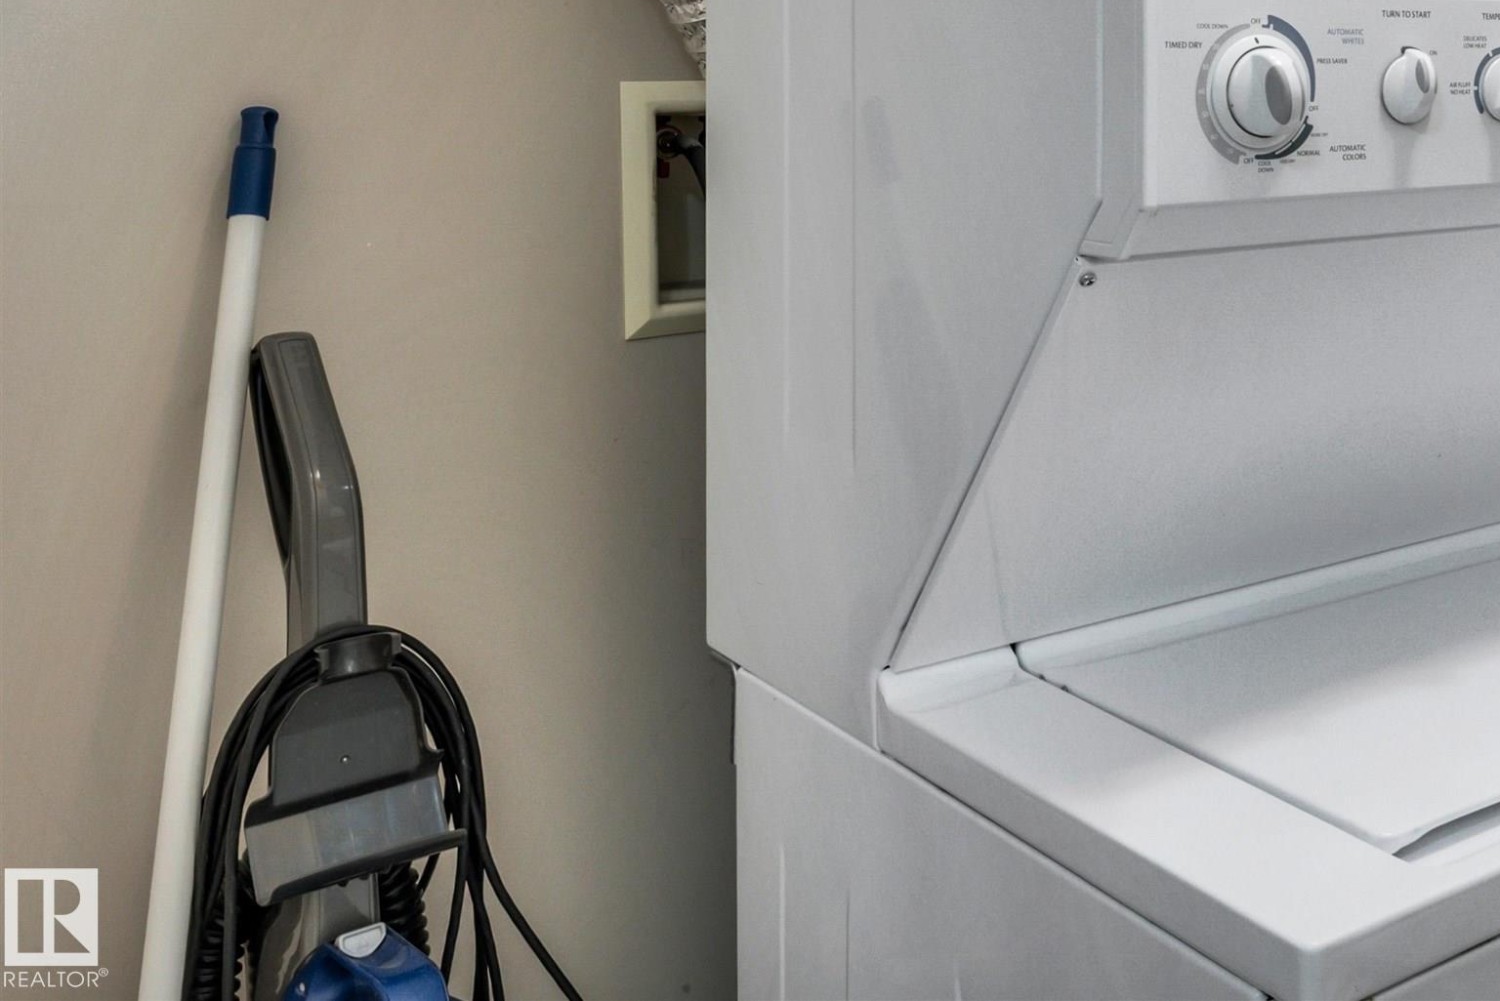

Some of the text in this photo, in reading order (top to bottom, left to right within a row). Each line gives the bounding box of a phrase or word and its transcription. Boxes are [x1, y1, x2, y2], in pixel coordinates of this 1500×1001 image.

[1382, 10, 1431, 18] TURN TO START
[1327, 27, 1364, 36] AUTOMATIC
[1165, 40, 1202, 49] TIMED DRY
[1341, 37, 1365, 45] WHITES
[1329, 144, 1366, 152] AUTOMATIC
[1342, 153, 1366, 161] COLORS
